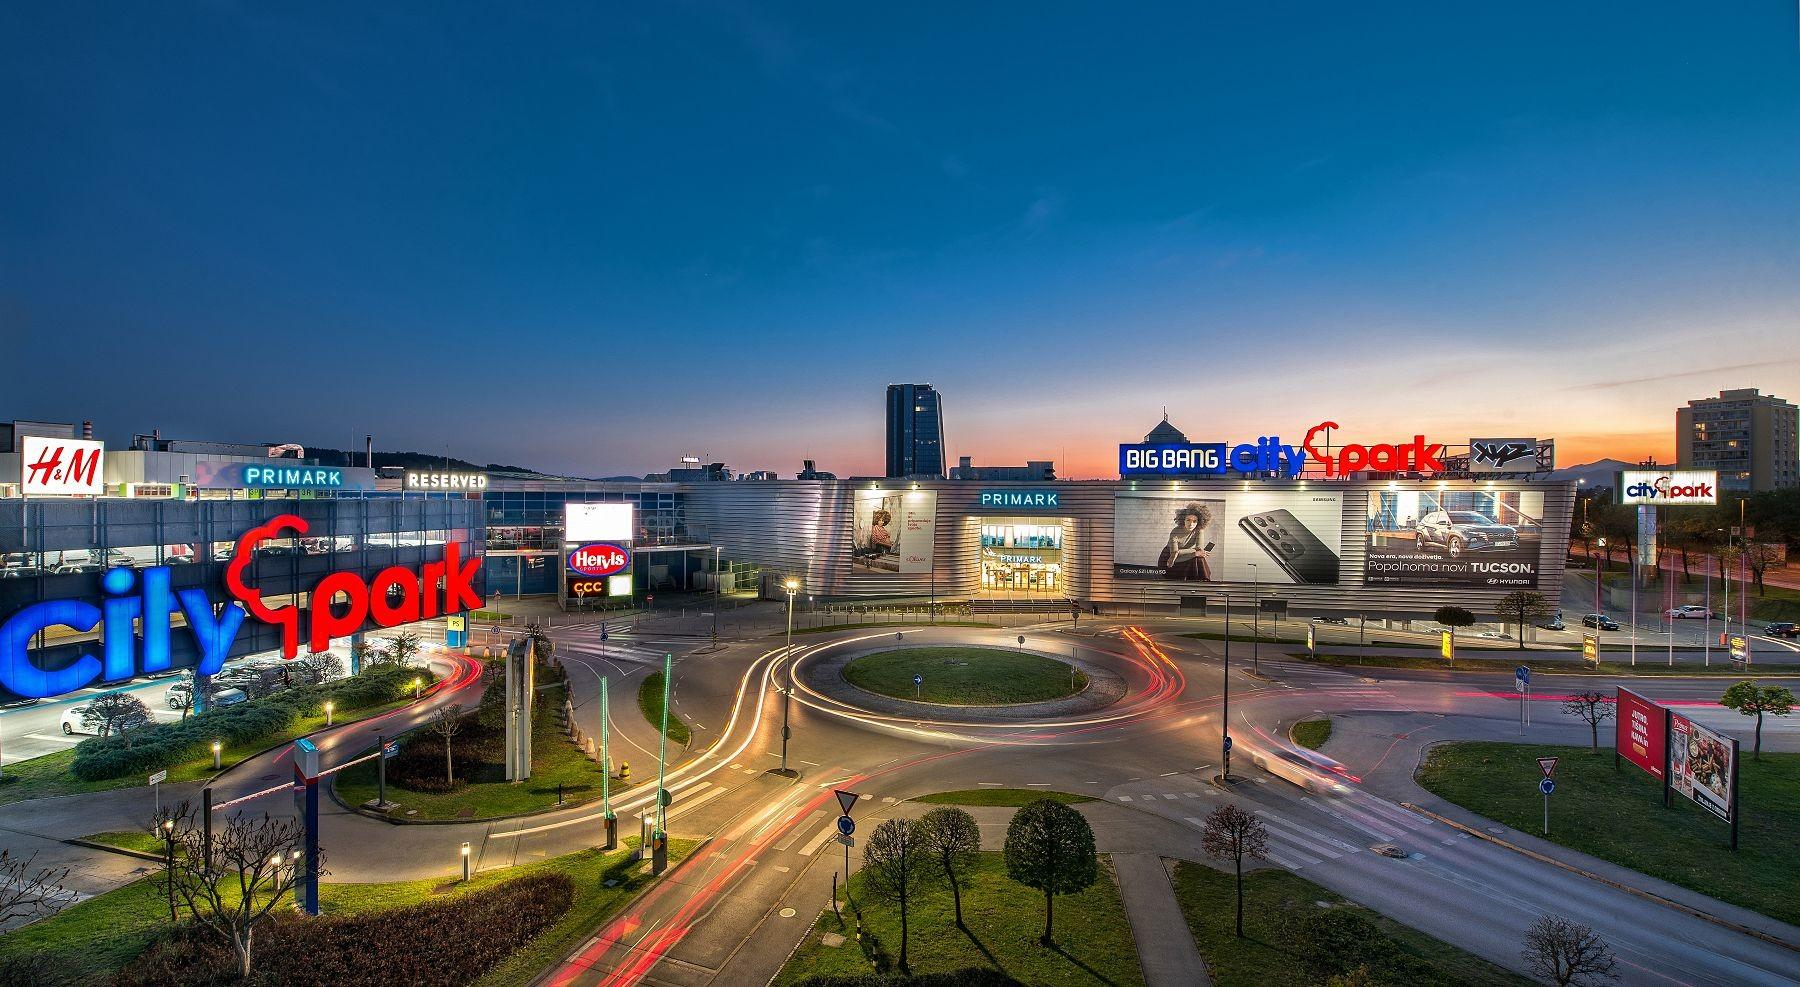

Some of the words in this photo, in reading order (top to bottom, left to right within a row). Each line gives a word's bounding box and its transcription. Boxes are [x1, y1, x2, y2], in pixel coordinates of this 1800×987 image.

[1126, 449, 1160, 469] BIG
[1162, 449, 1219, 469] BANG
[1230, 435, 1306, 476] city
[1339, 434, 1445, 476] park
[27, 446, 101, 486] H&M
[246, 467, 342, 485] PRIMARK
[408, 472, 487, 488] RESERVED
[1626, 482, 1658, 498] city
[1669, 482, 1713, 498] park
[982, 493, 1058, 506] PRIMARK
[575, 550, 625, 569] Hervis
[1368, 560, 1439, 573] Popolnoma
[1442, 561, 1467, 573] novi
[1470, 562, 1535, 574] TUCSON.
[573, 582, 602, 592] CCC
[0, 565, 246, 699] city
[308, 542, 485, 653] park
